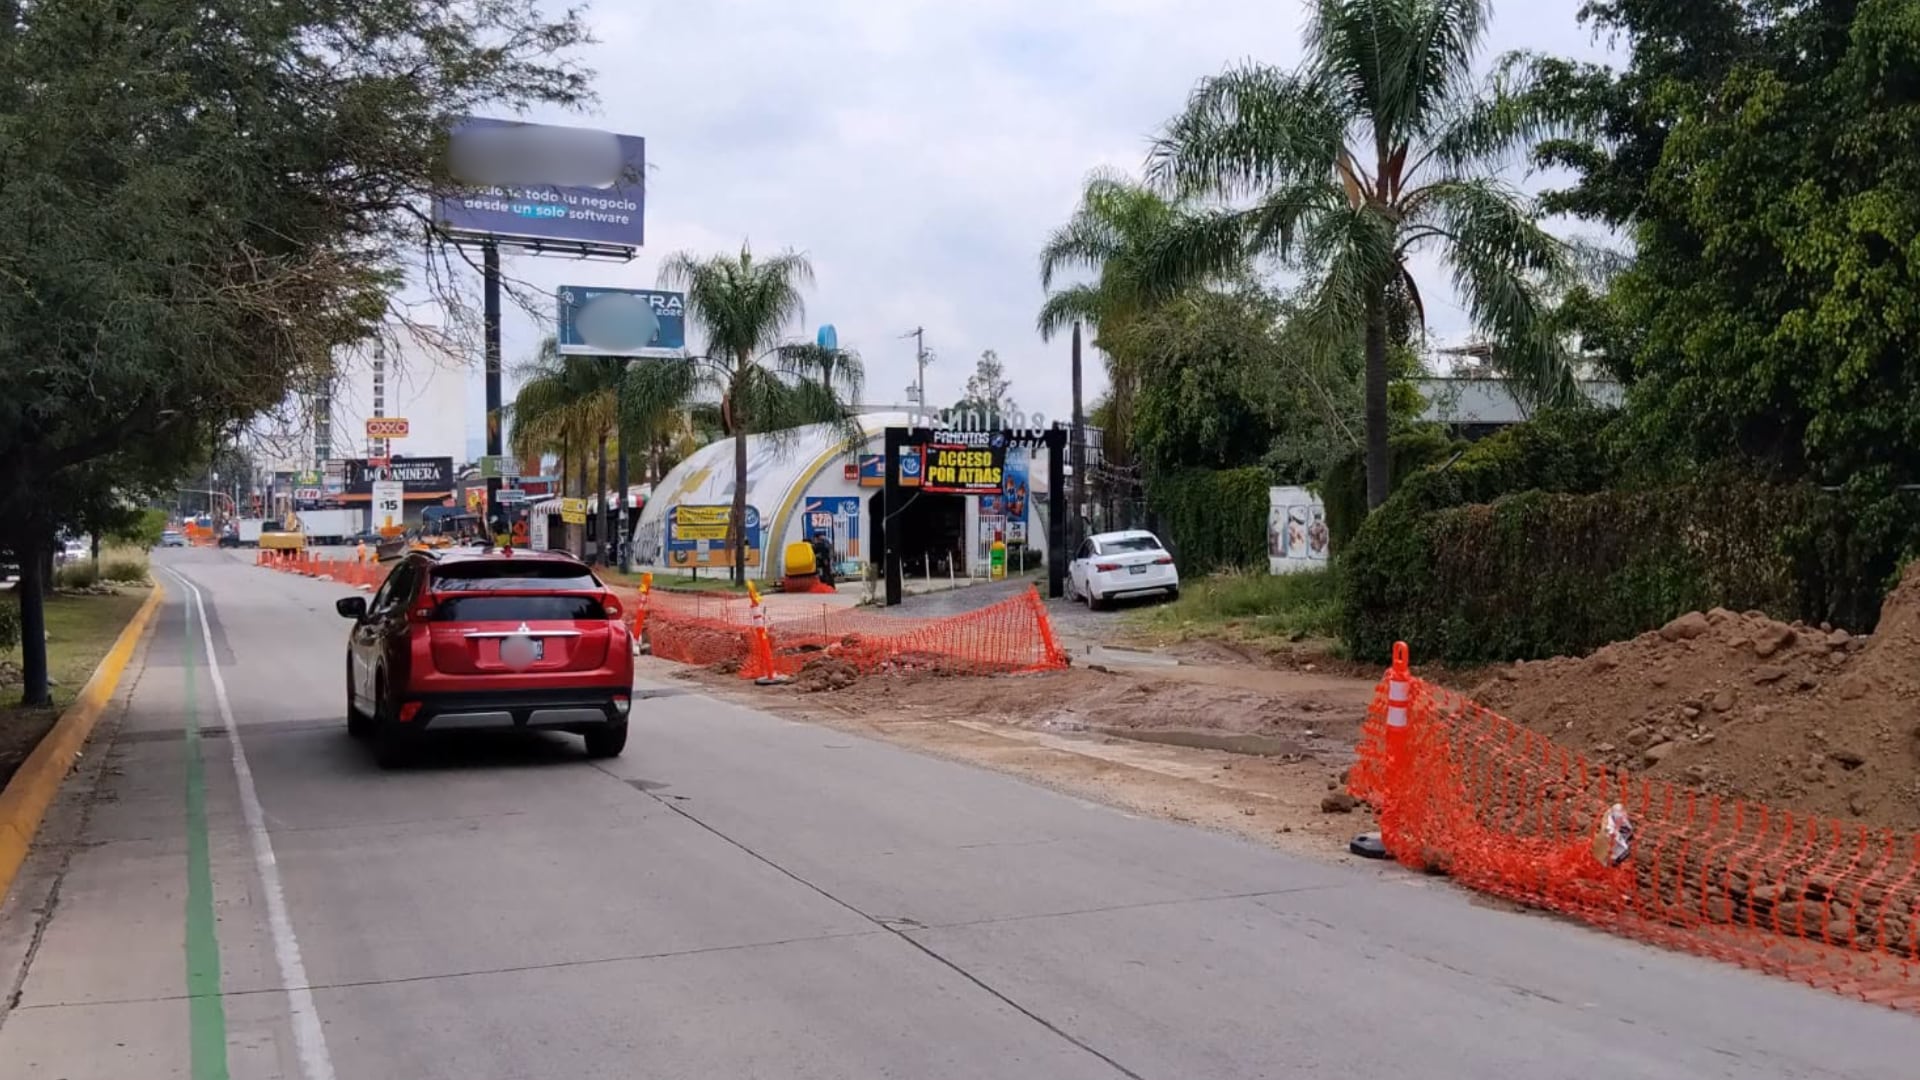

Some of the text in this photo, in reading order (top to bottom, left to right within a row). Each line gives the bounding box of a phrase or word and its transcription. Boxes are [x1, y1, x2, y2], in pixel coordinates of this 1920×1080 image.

[525, 189, 558, 202] todo
[581, 196, 637, 211] negocio
[464, 199, 629, 225] desde un solo software
[368, 422, 408, 434] OXXO
[933, 431, 990, 445] PANDITAS
[938, 451, 992, 467] ACCESO
[928, 466, 1001, 483] POR ATRAS
[379, 500, 398, 511] $15
